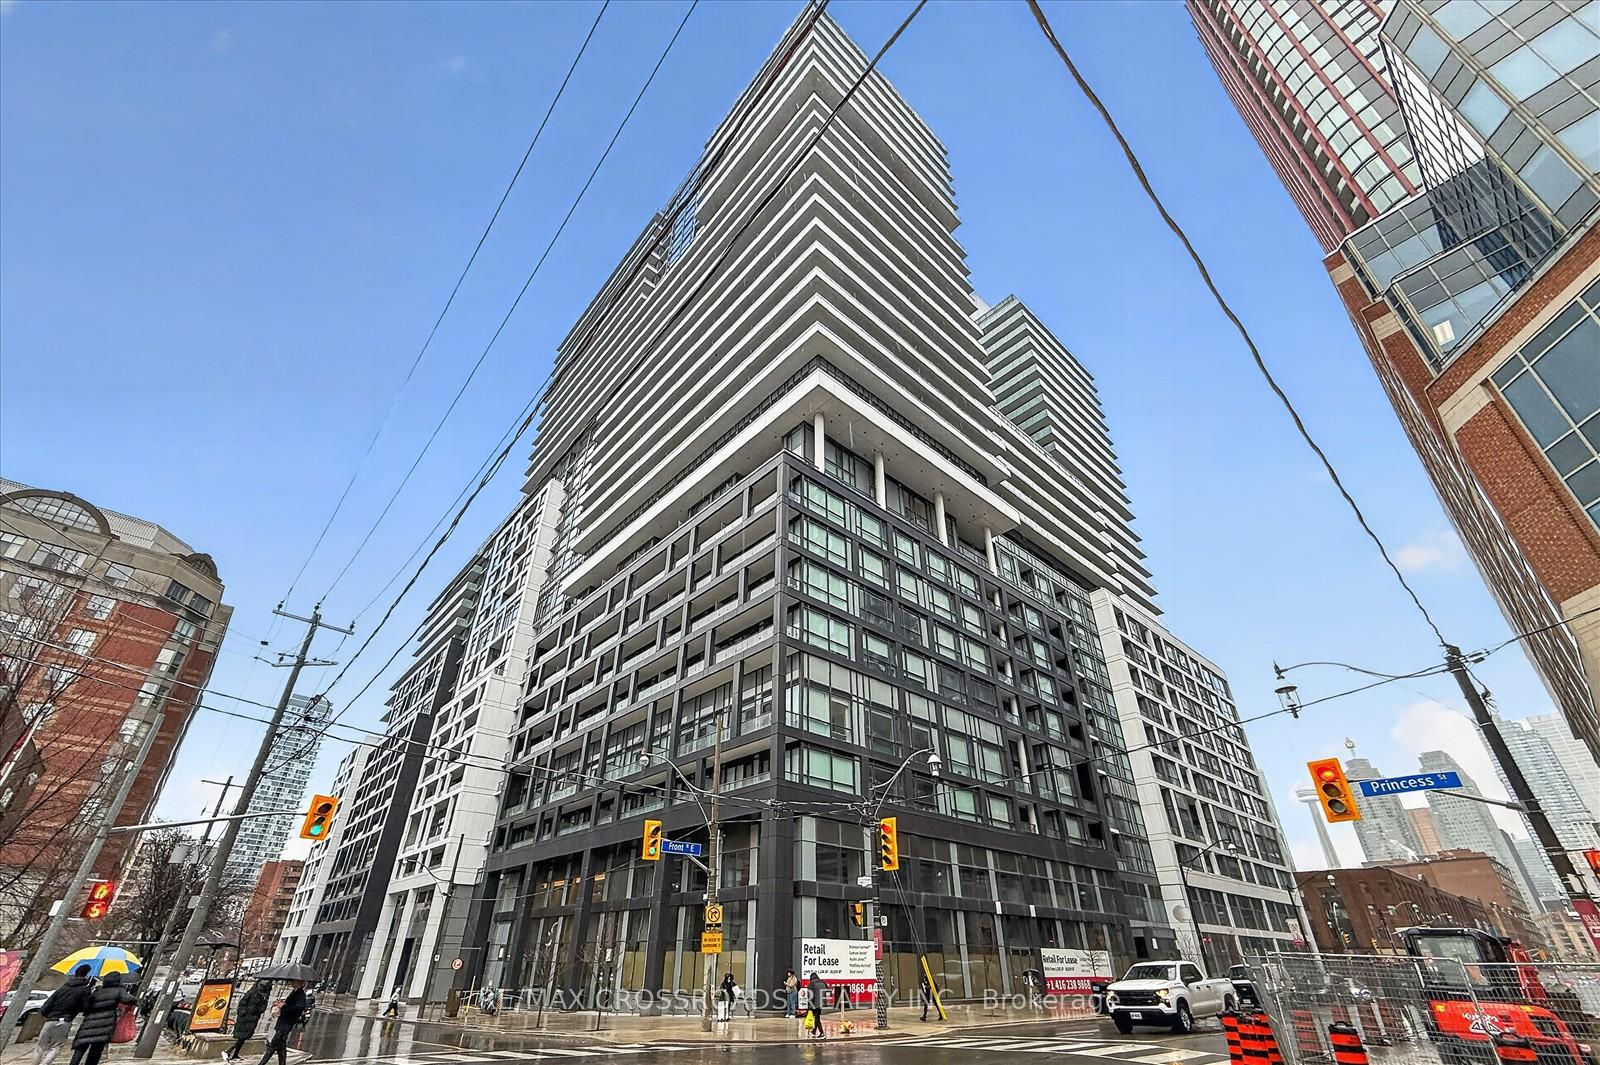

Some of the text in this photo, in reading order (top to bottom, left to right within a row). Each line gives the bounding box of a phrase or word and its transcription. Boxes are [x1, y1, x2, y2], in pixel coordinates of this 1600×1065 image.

[1370, 776, 1435, 792] Princess
[668, 842, 684, 852] Front
[690, 844, 695, 852] E
[803, 943, 826, 955] Retail
[803, 955, 840, 966] For Lease
[1042, 954, 1078, 964] Retail For Lease
[1046, 980, 1055, 990] +1
[1055, 980, 1066, 990] 416
